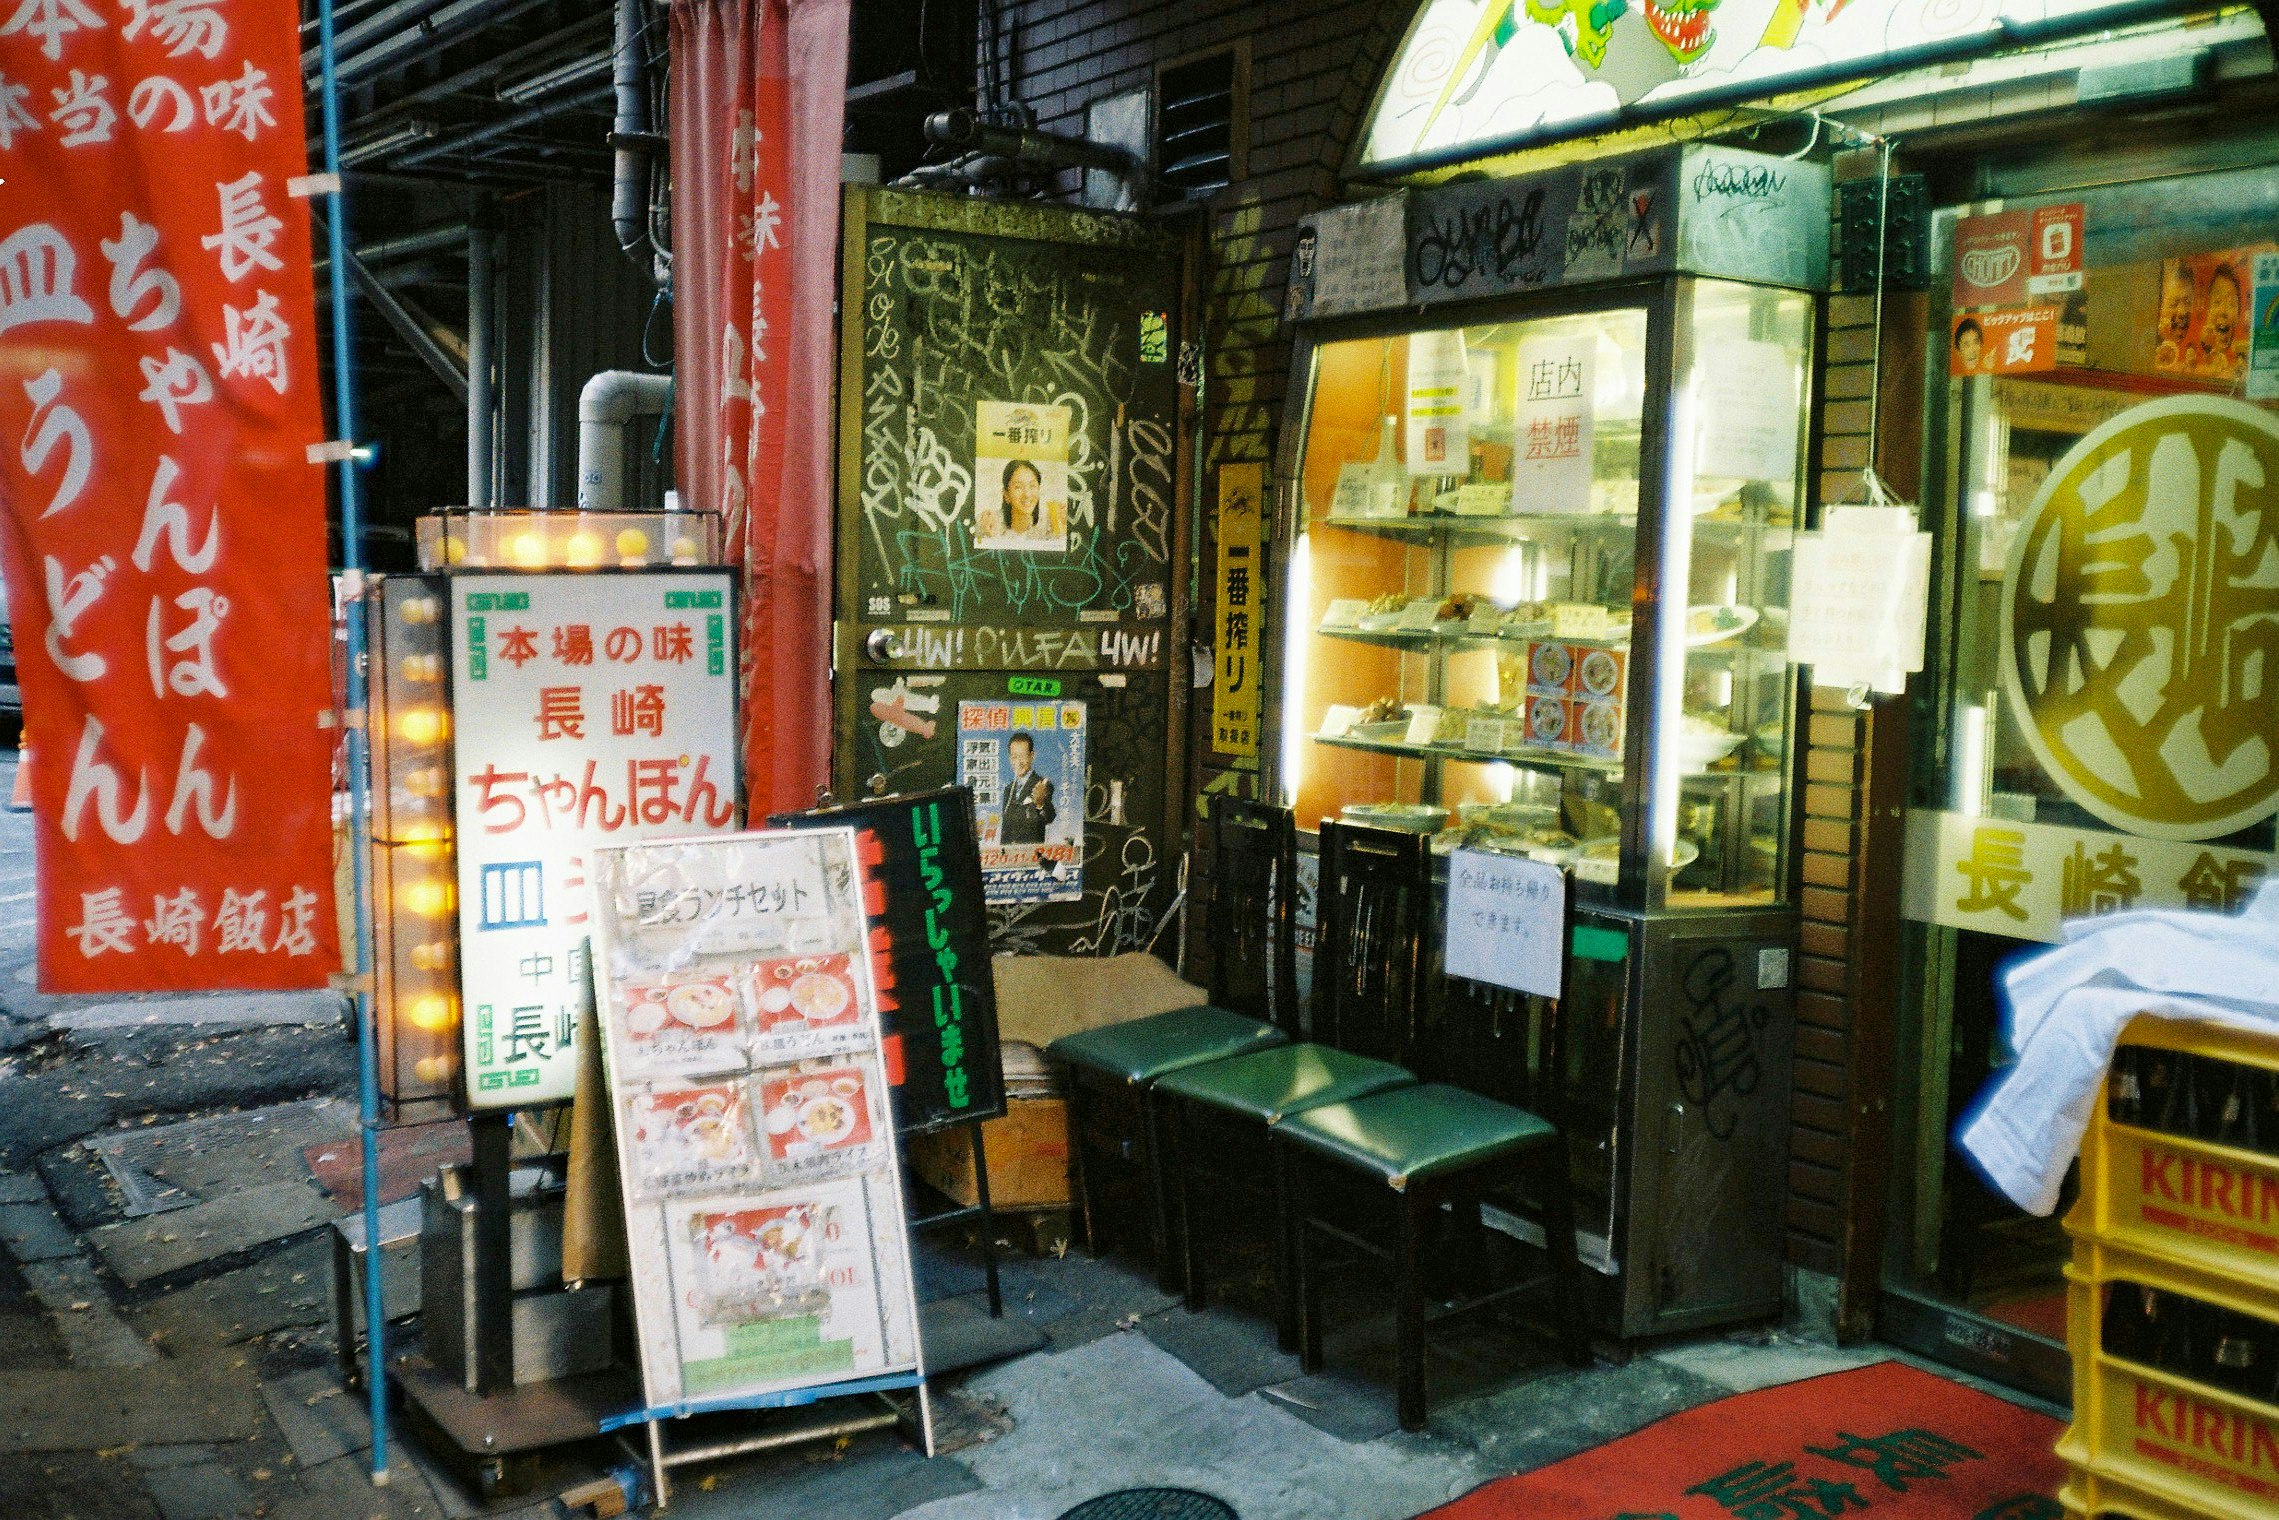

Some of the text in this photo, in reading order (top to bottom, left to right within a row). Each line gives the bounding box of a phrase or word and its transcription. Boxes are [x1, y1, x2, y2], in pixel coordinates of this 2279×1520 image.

[202, 170, 292, 395] 長崎
[1527, 355, 1583, 402] 店内
[992, 426, 1052, 445] 一番搾り
[1525, 415, 1582, 460] 禁煙
[0, 222, 147, 846] 皿うどん
[100, 209, 238, 840] ちゃんぽん
[497, 622, 695, 668] 本場の味
[1224, 545, 1251, 692] 一番搾り
[532, 683, 667, 743] 長崎
[467, 752, 735, 836] ちゃんぽん
[66, 885, 319, 958] 長崎飯店
[911, 802, 971, 1109] いらっしゃいませ
